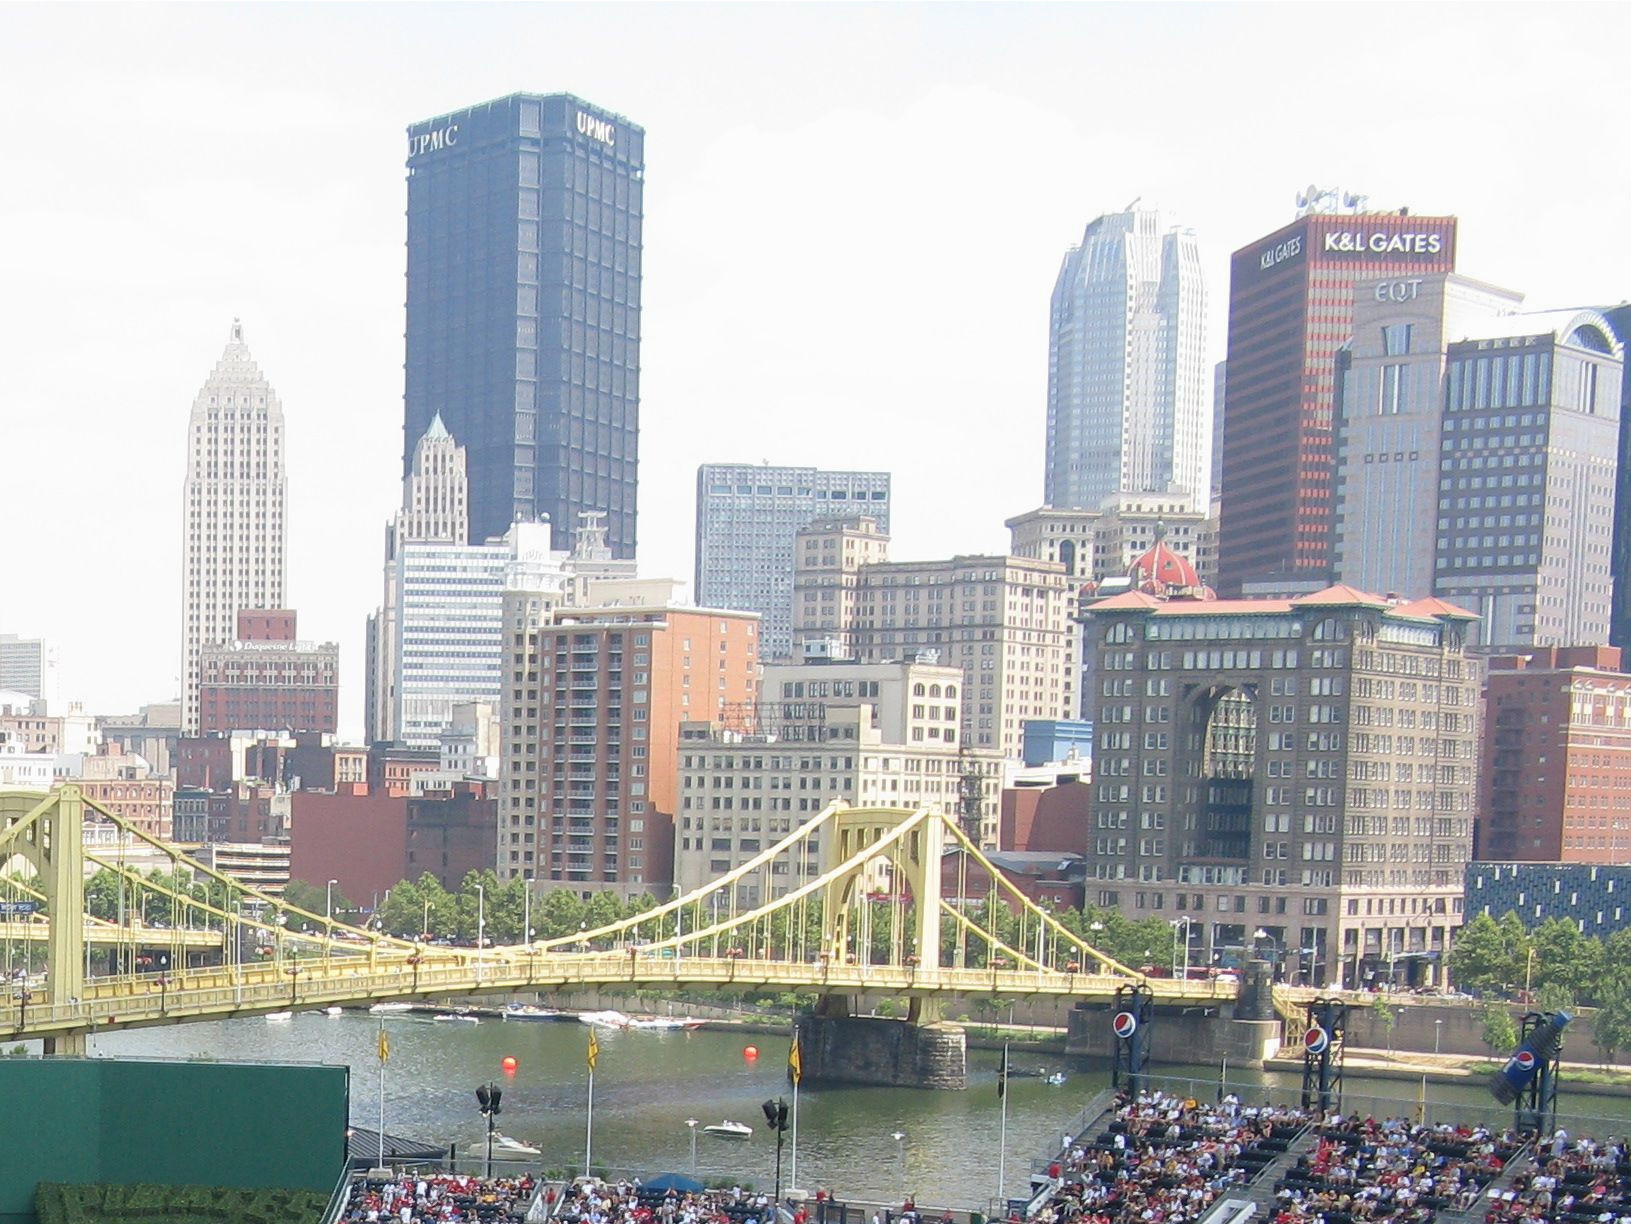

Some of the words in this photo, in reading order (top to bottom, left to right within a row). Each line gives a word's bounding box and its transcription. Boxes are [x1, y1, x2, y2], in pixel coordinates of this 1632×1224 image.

[577, 111, 617, 146] UPMC
[1275, 236, 1301, 263] GATES
[1325, 232, 1367, 251] K&L
[1369, 233, 1441, 253] GATES
[1375, 279, 1423, 302] EQT
